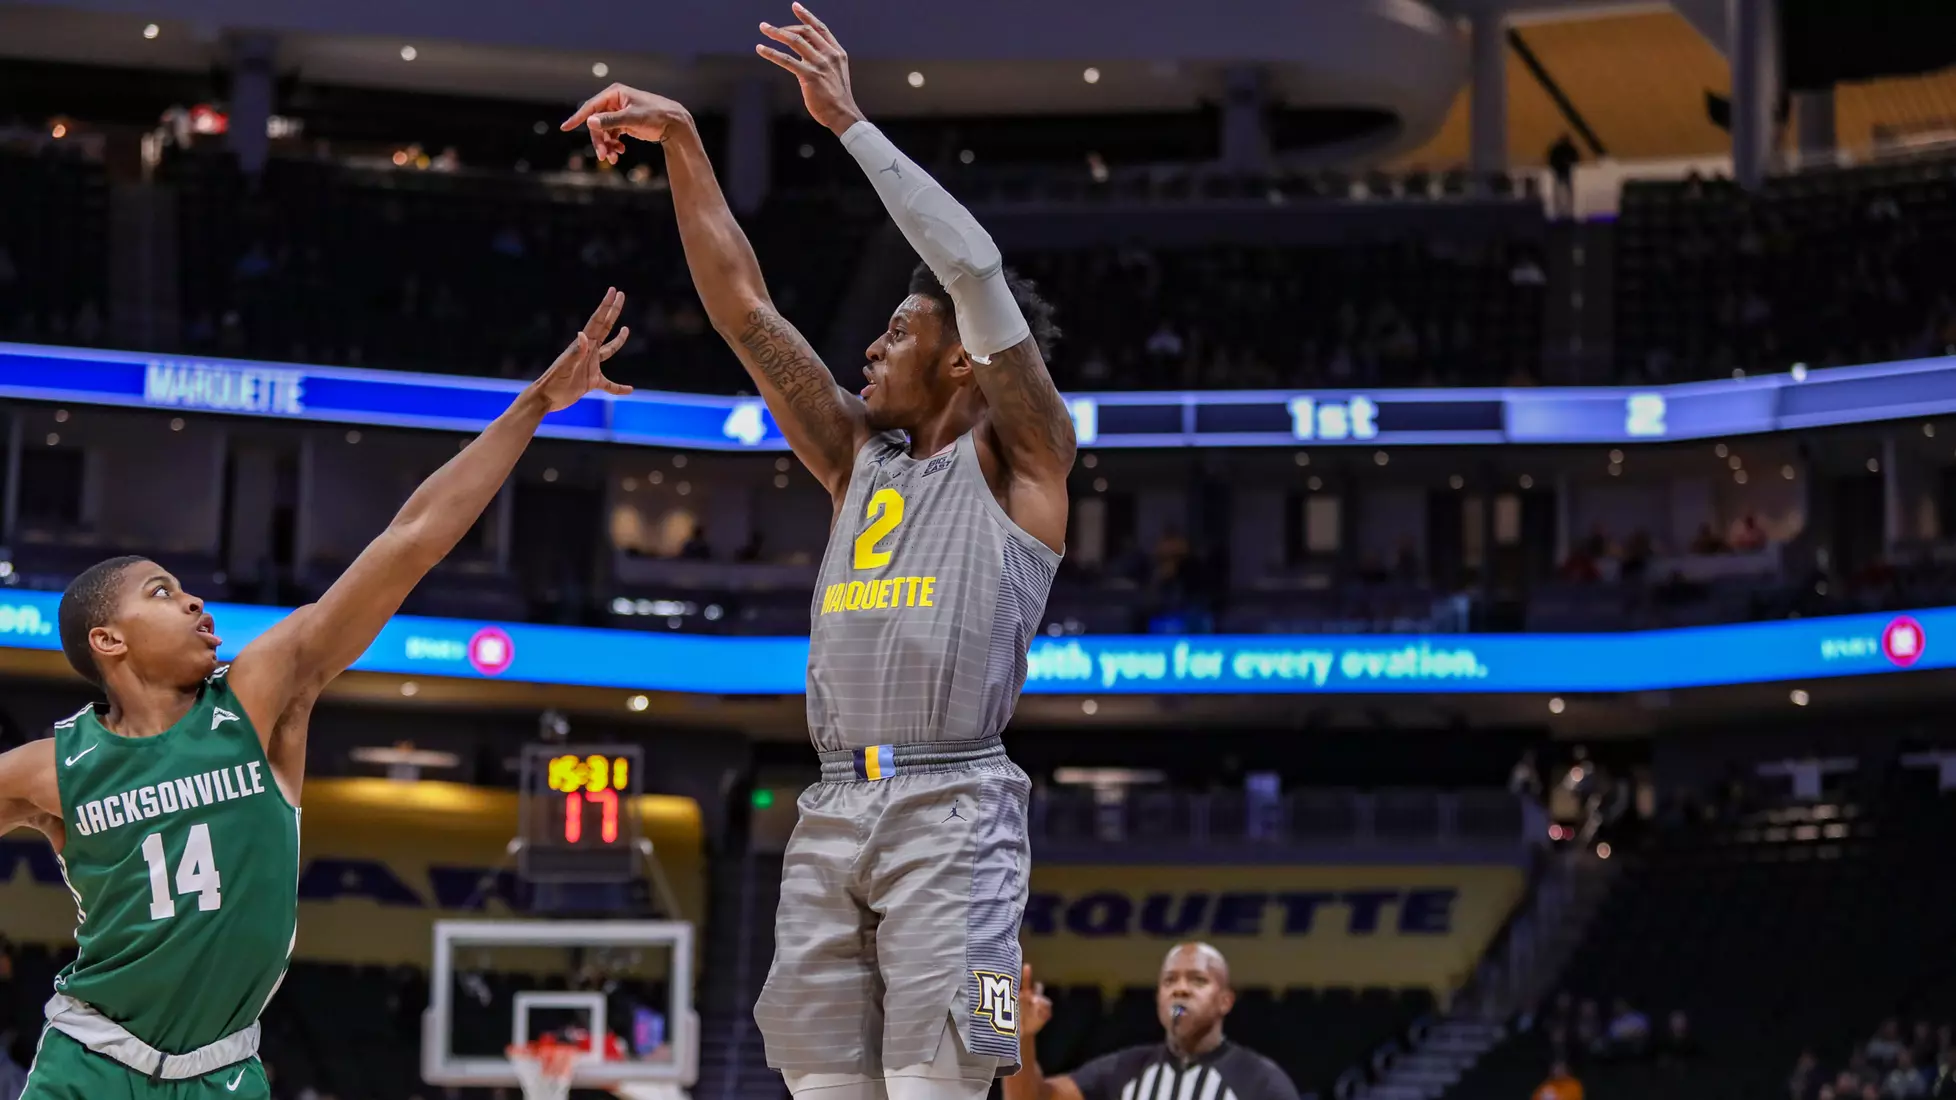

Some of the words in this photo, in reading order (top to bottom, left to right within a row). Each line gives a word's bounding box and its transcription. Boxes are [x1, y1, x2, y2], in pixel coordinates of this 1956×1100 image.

[723, 403, 767, 445] 4
[1287, 396, 1378, 440] 1st
[1626, 392, 1667, 436] 2
[924, 461, 952, 475] EAST
[929, 456, 948, 468] BIG
[854, 488, 905, 570] 2
[820, 576, 937, 616] MAQUETTE
[1099, 651, 1167, 688] you
[1174, 639, 1222, 680] for
[1233, 650, 1334, 687] every
[1340, 640, 1488, 680] ovation.
[75, 760, 265, 836] JACKSONVILLE
[565, 788, 618, 843] 17
[141, 823, 221, 921] 14
